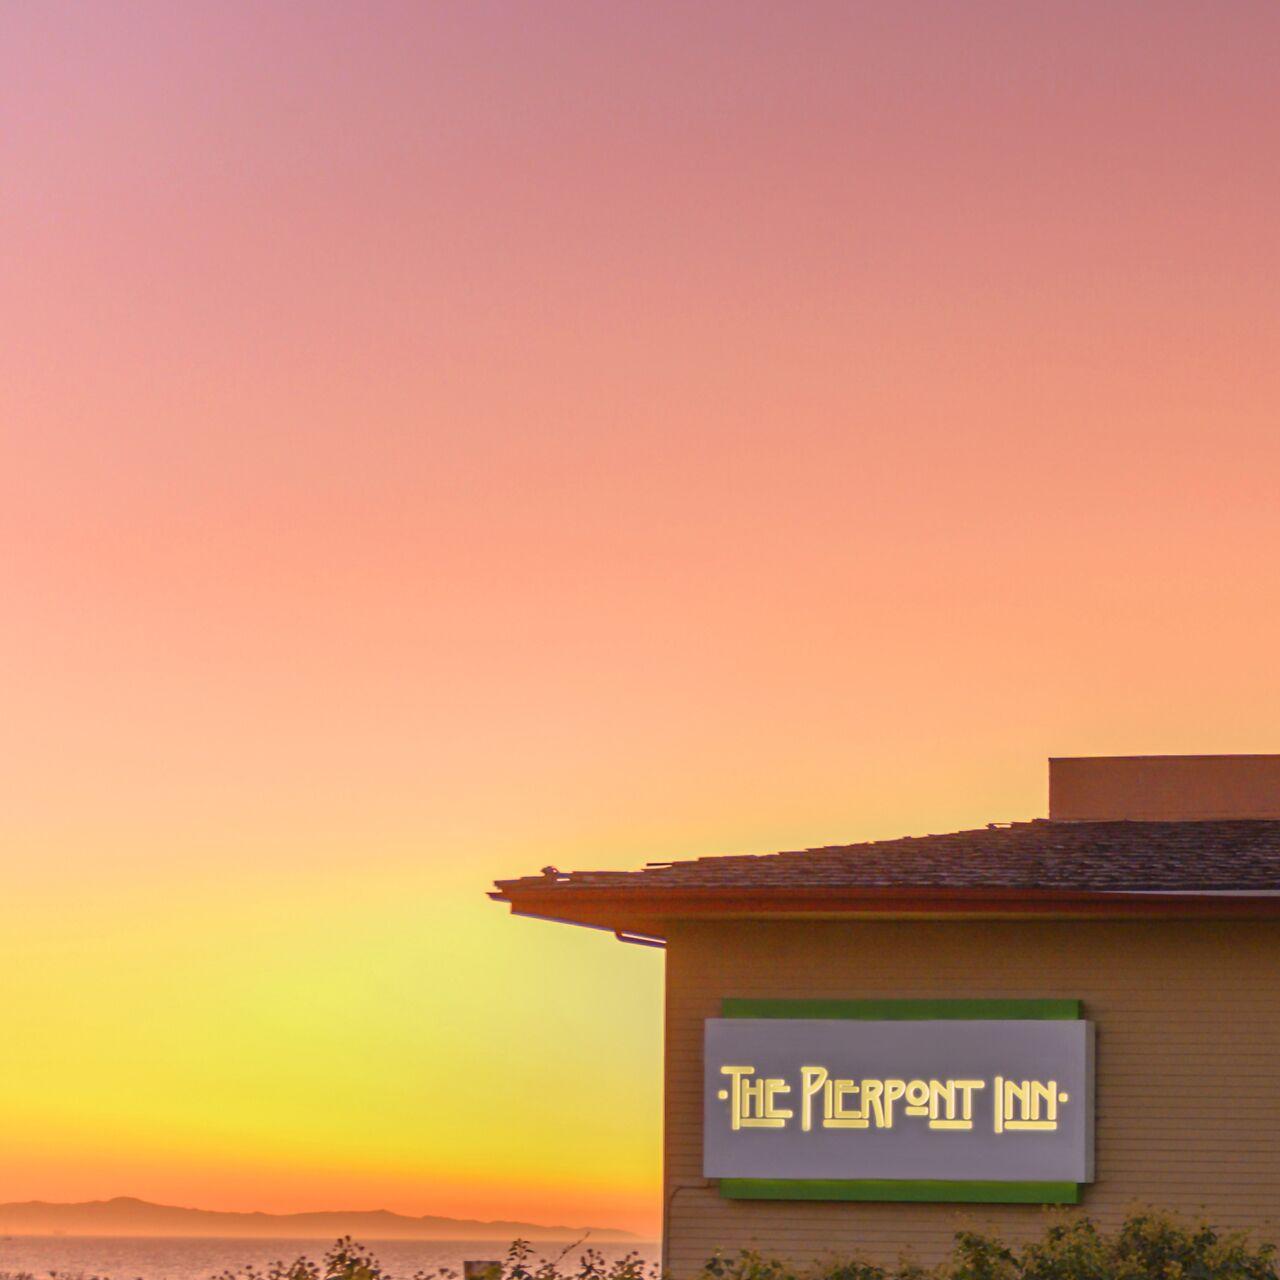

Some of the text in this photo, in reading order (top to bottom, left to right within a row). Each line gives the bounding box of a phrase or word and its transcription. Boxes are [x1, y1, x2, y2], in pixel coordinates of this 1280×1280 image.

[720, 1065, 1058, 1134] THE PIERPONT INN
